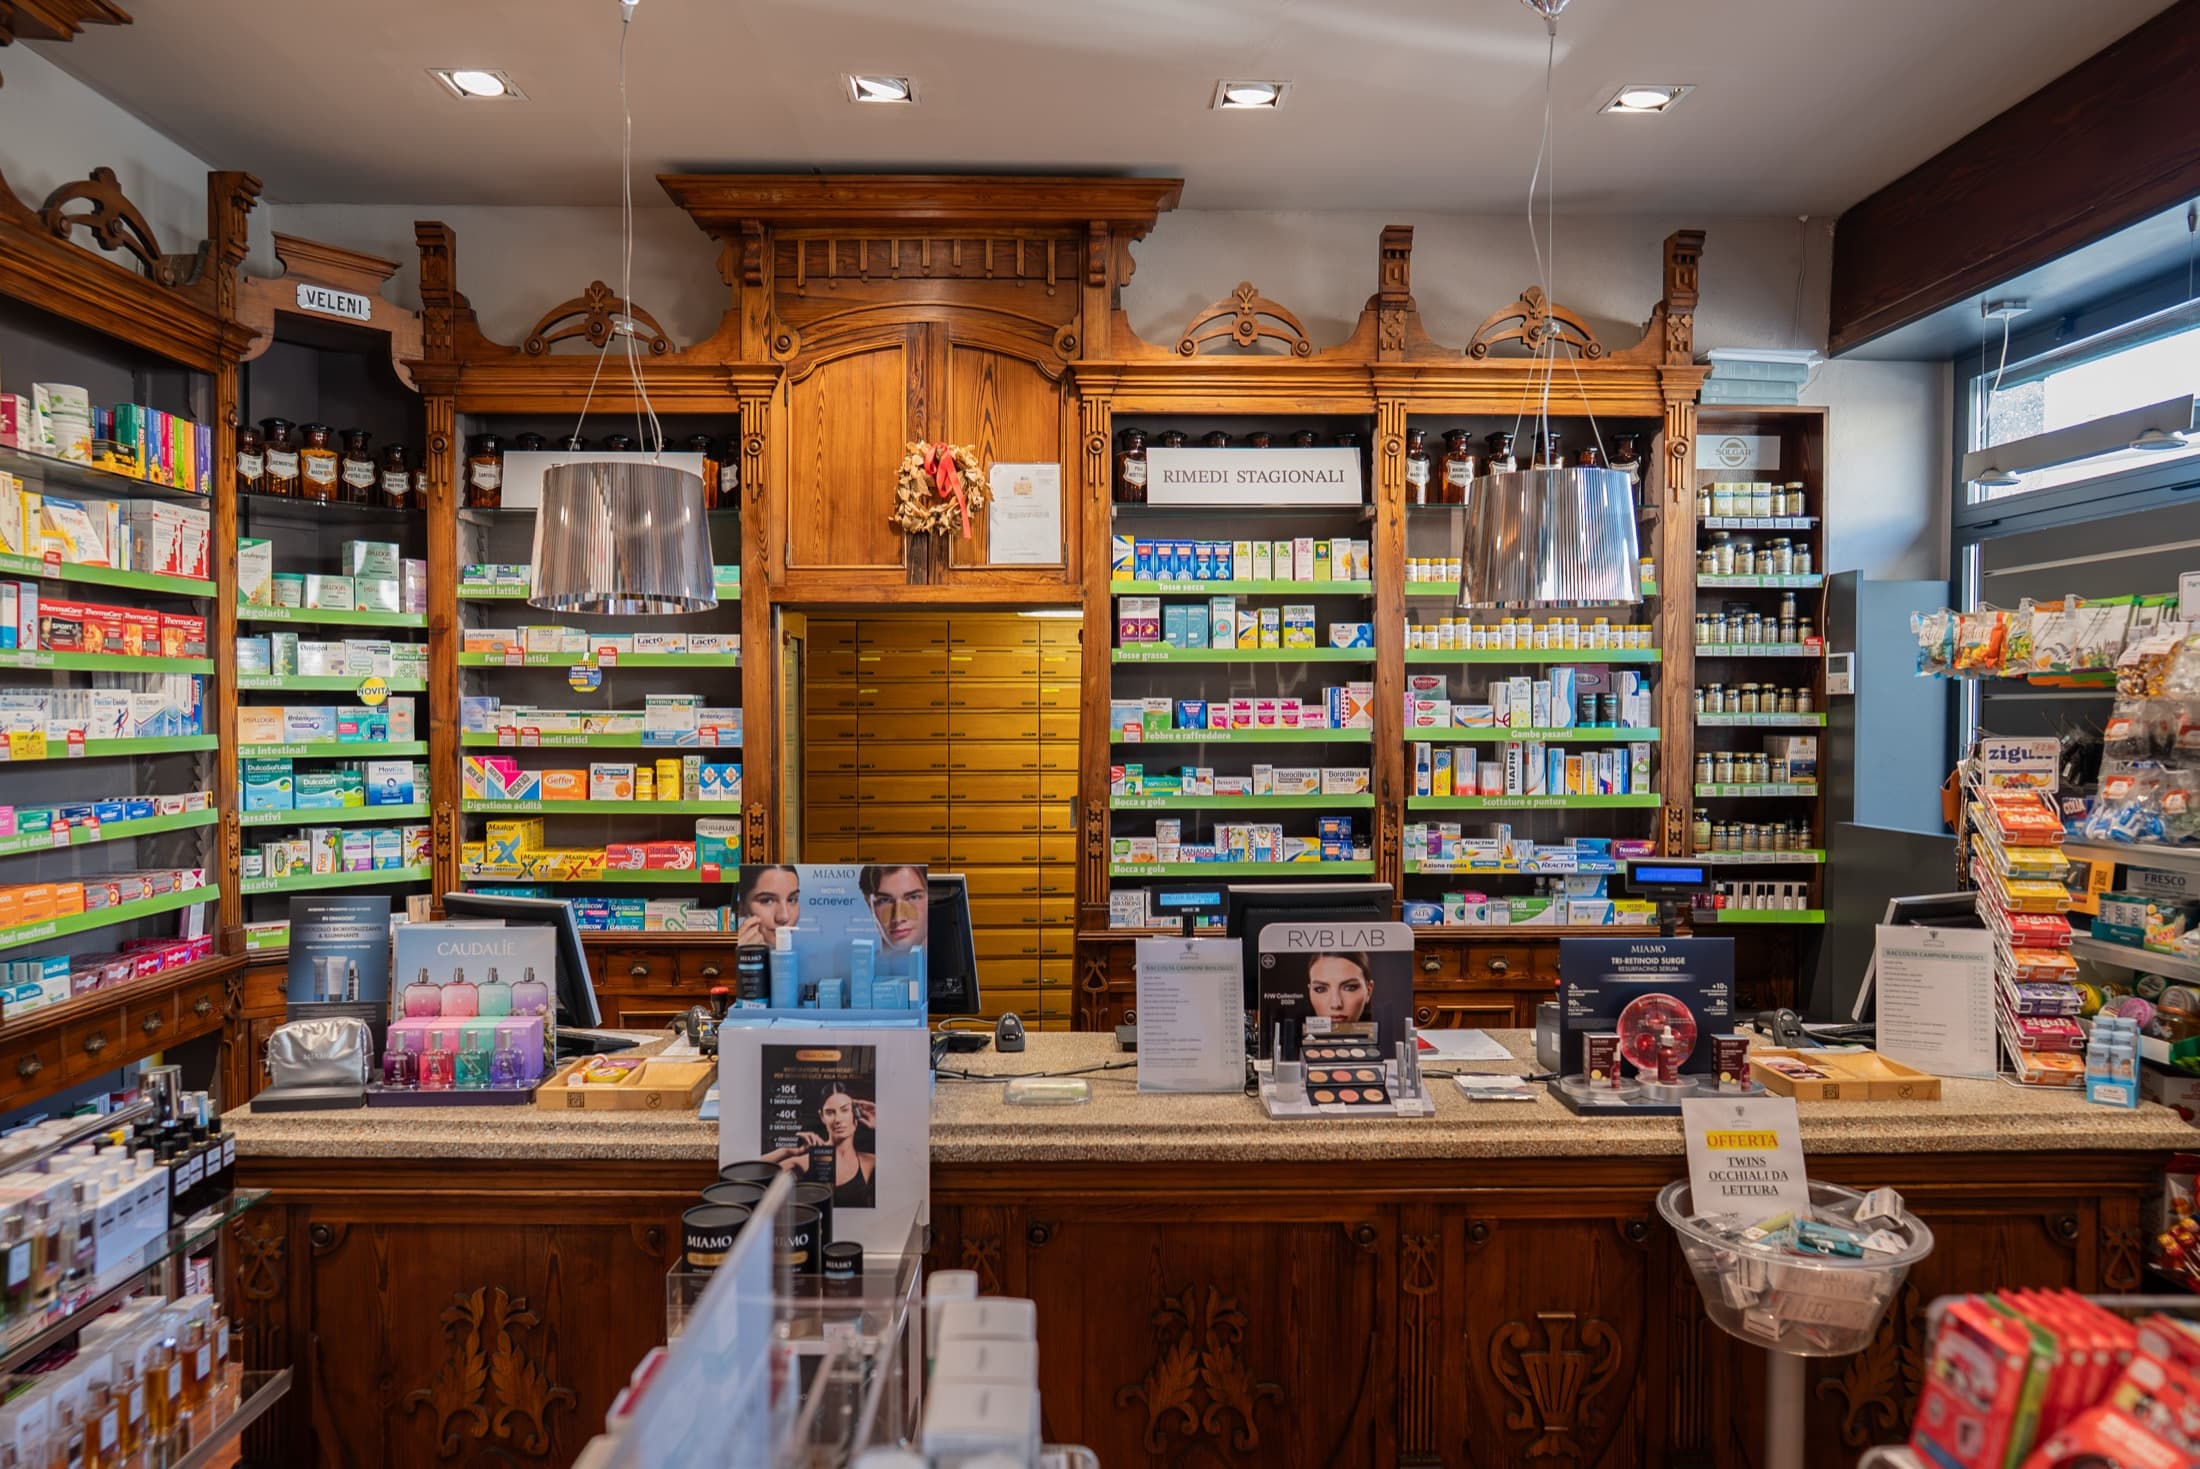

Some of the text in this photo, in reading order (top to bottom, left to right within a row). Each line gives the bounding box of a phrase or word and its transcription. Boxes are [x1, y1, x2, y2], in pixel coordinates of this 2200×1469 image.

[306, 289, 364, 316] VELENI
[1715, 447, 1751, 457] SOLGAR
[1162, 469, 1345, 484] RIMEDI STAGIONALI
[39, 603, 84, 616] ThermaCare
[85, 607, 122, 619] ThermaCare
[124, 612, 159, 623] ThermaCare
[163, 616, 203, 627] ThermaCare
[636, 637, 664, 647] Lacto
[690, 637, 718, 647] Lacto
[1117, 651, 1169, 662] Tosse grassa
[238, 676, 283, 688] egolarità
[1145, 731, 1172, 740] Febbre
[1180, 731, 1232, 741] raffreddore
[258, 745, 307, 755] intestinali
[1278, 770, 1312, 779] Borocillina
[1328, 770, 1362, 779] Borocillina
[1508, 751, 1516, 790] BIAFIN
[303, 778, 337, 787] DulcoSoft
[546, 775, 573, 785] Geffer
[467, 801, 543, 813] Digestione acidità
[1114, 797, 1139, 807] Bocca
[1146, 797, 1166, 809] gola
[1482, 797, 1524, 807] Scottature
[1533, 798, 1567, 809] punture
[487, 823, 516, 832] Maalox
[564, 853, 591, 861] Maalox
[1181, 847, 1213, 856] SANAGOL
[523, 853, 549, 862] Maalox
[471, 862, 483, 875] 3
[1114, 864, 1139, 874] Bocca
[1146, 864, 1166, 876] gola
[1423, 862, 1447, 870] Azione
[1447, 862, 1468, 872] rapida
[1540, 861, 1577, 870] REACTINE
[811, 868, 856, 880] MIAMO
[240, 880, 278, 892] assativi
[2143, 874, 2187, 887] FRESCO
[808, 897, 857, 908] acnever
[575, 923, 603, 931] AVISCON
[609, 923, 640, 931] GAVISCON
[1288, 928, 1386, 948] RVB LAB
[1630, 945, 1667, 954] MIAMO
[1610, 956, 1686, 965] TRI-RETINOID SURGE
[776, 1084, 797, 1095] -10€
[776, 1109, 797, 1120] -40€
[1706, 1134, 1779, 1148] OFFERTA
[1726, 1156, 1767, 1168] TWINS
[1708, 1170, 1789, 1182] OCCHIALI DA
[1721, 1184, 1780, 1197] LETTURA
[686, 1234, 733, 1249] MIAMO
[825, 1260, 852, 1269] MIAMO
